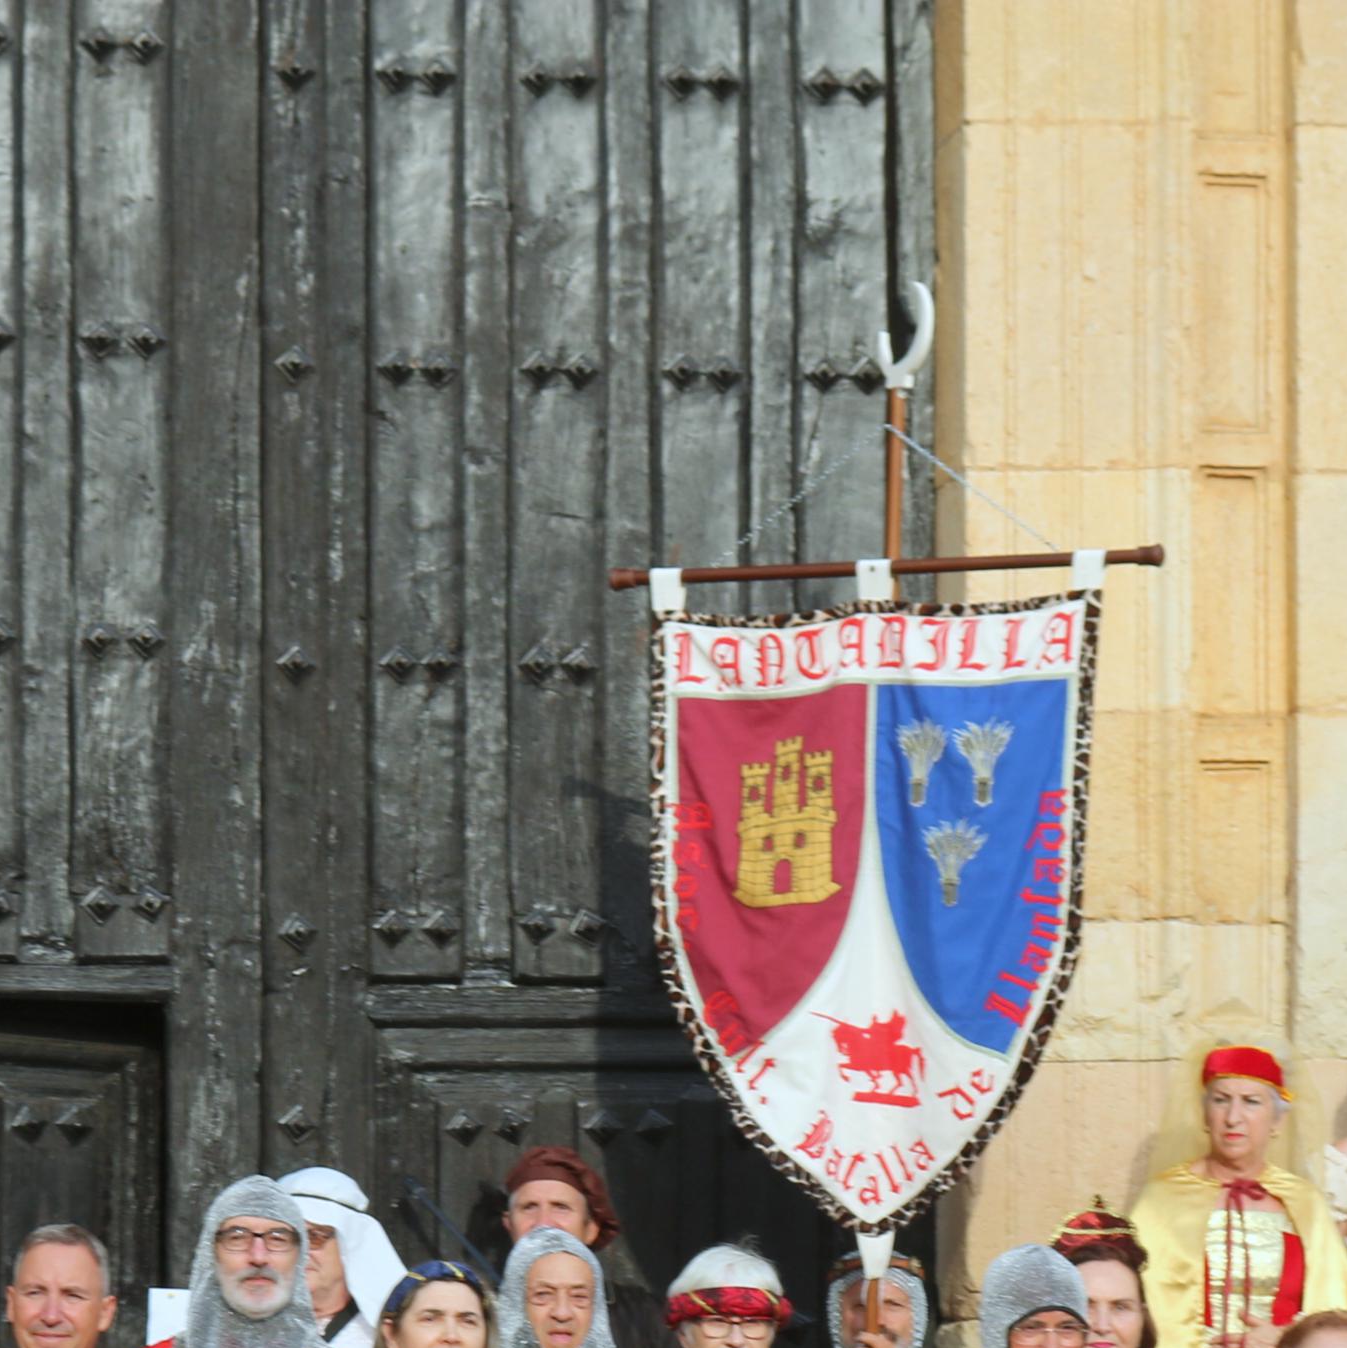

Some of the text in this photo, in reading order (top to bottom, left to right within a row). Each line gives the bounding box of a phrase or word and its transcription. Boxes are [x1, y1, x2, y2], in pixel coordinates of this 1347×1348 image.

[673, 611, 1074, 692] LANTADILLA
[669, 789, 1068, 1206] Asoc. Cult. Batalla de Llantada
